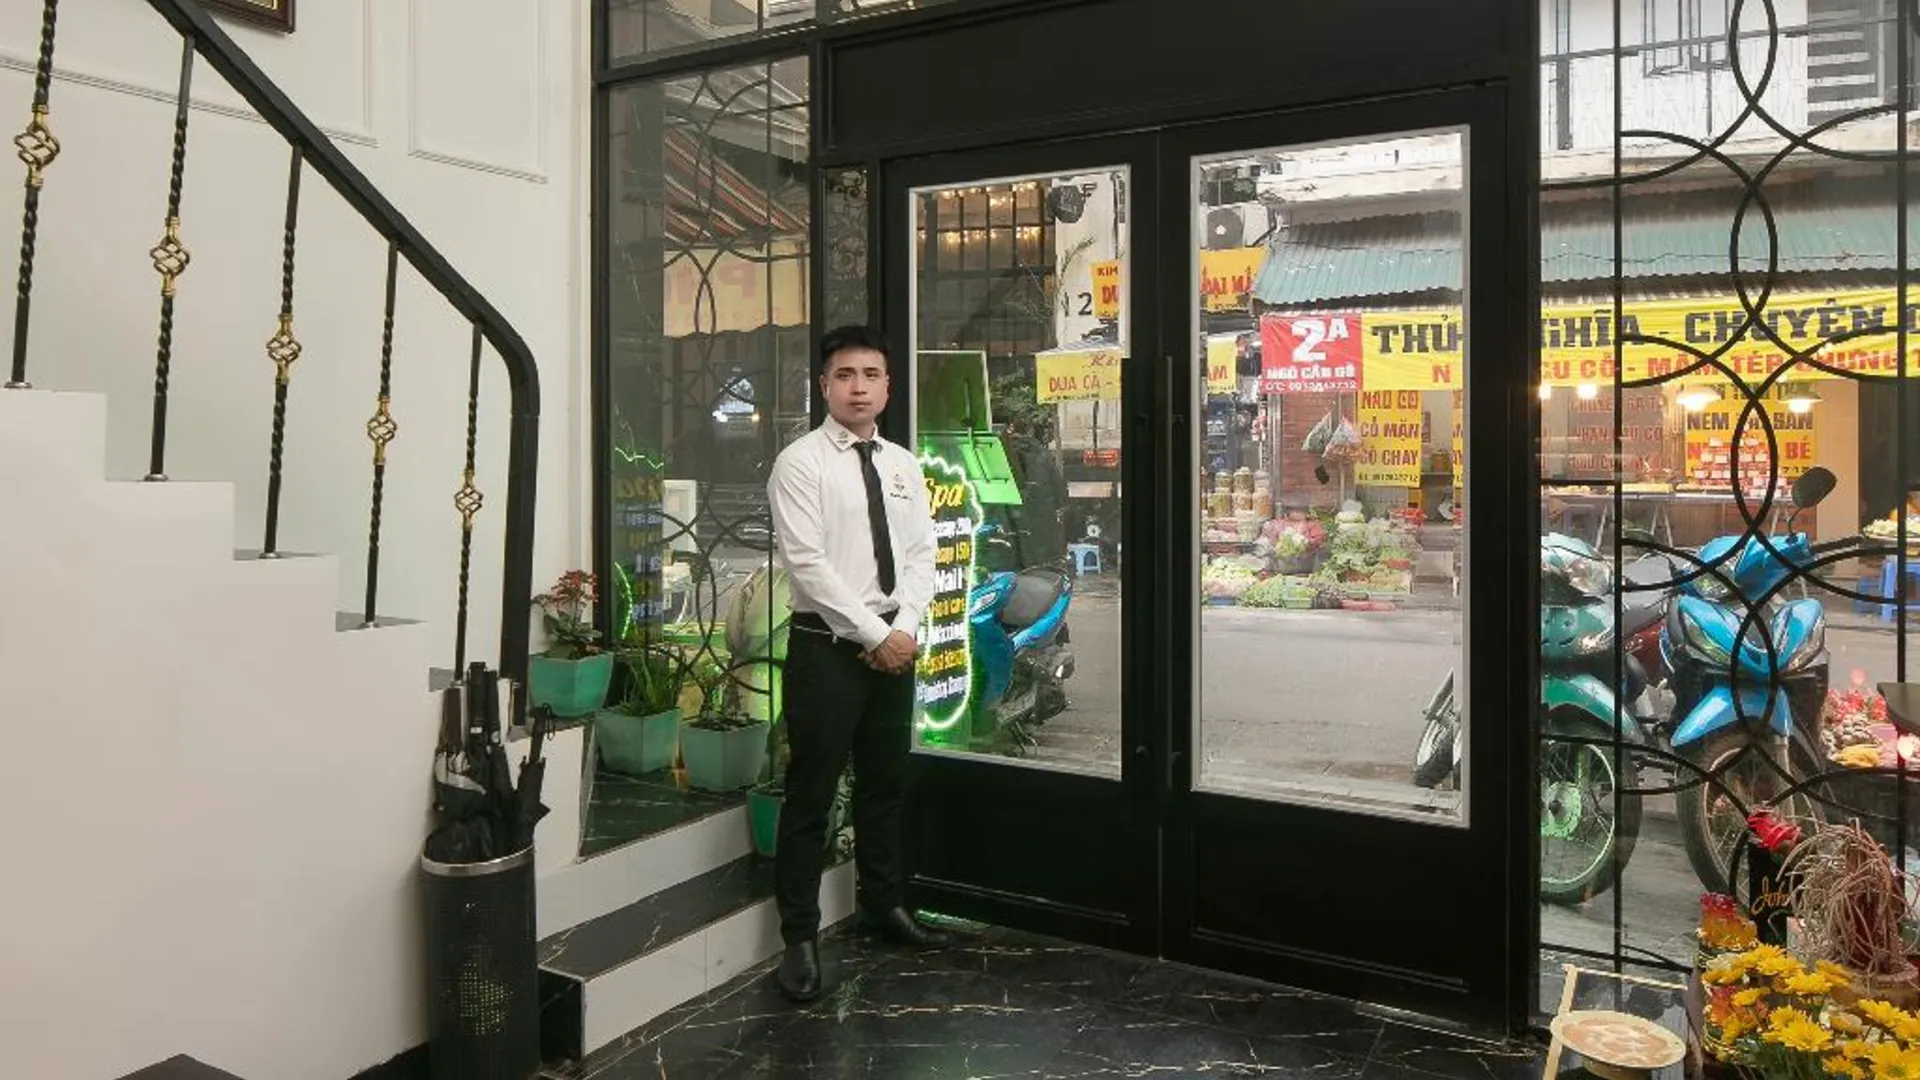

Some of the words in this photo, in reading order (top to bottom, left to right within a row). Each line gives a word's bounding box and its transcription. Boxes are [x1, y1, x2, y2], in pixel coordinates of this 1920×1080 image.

[1291, 318, 1349, 363] 2A
[1687, 412, 1729, 430] NEM
[1382, 449, 1419, 465] CHAY
